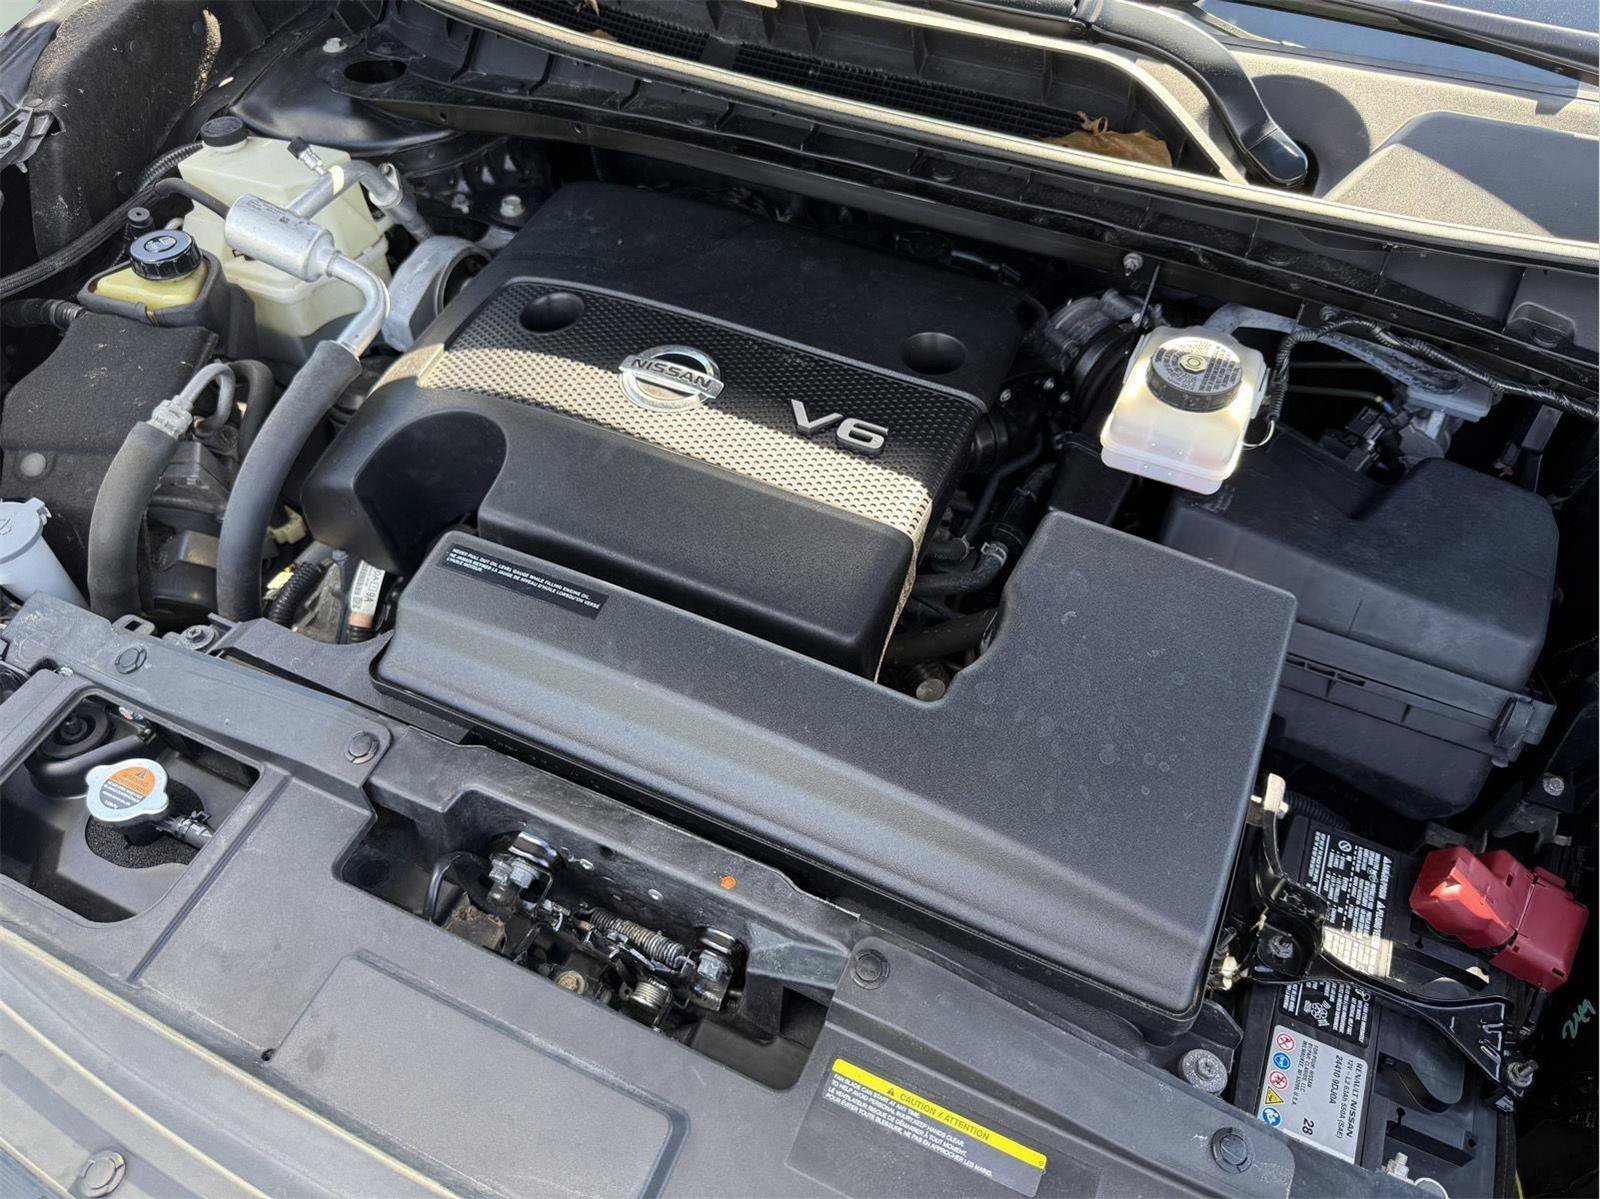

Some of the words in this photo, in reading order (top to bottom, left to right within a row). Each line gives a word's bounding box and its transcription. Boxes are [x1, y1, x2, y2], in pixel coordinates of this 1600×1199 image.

[631, 358, 712, 390] NISSAN
[791, 399, 889, 455] V6
[513, 569, 529, 577] GAUGE
[544, 580, 562, 589] FILLING
[563, 587, 581, 596] ENGINE
[1333, 1055, 1342, 1078] 24410
[1353, 1063, 1362, 1098] RENAULT
[831, 1079, 840, 1087] TO
[839, 1083, 853, 1093] HELP
[853, 1090, 869, 1101] AVOID
[869, 1097, 896, 1114] PERSONAL
[927, 1125, 946, 1138] HANDS
[946, 1135, 964, 1147] CLEAR.
[843, 1078, 861, 1090] BLADE
[861, 1086, 873, 1096] CAN
[873, 1092, 889, 1103] START
[896, 1103, 908, 1113] ANY
[826, 1092, 841, 1103] POUR
[841, 1099, 859, 1112] ÉVITER
[859, 1108, 876, 1120] TOUTE
[912, 1134, 922, 1142] PAS
[922, 1139, 931, 1147] EN
[931, 1143, 964, 1163] APPROCHER
[964, 1159, 974, 1168] LES
[828, 1085, 836, 1093] LE
[835, 1089, 869, 1109] VENTILATEUR
[868, 1105, 888, 1118] RISQUE
[887, 1114, 896, 1122] DE
[895, 1118, 924, 1136] DÉMARRER
[929, 1135, 943, 1145] TOUT
[900, 1093, 936, 1115] CAUTION
[944, 1114, 989, 1141] ATTENTION
[1302, 1117, 1315, 1136] 28
[1336, 1119, 1344, 1139] (SAE)
[1347, 1100, 1357, 1138] NISSAN
